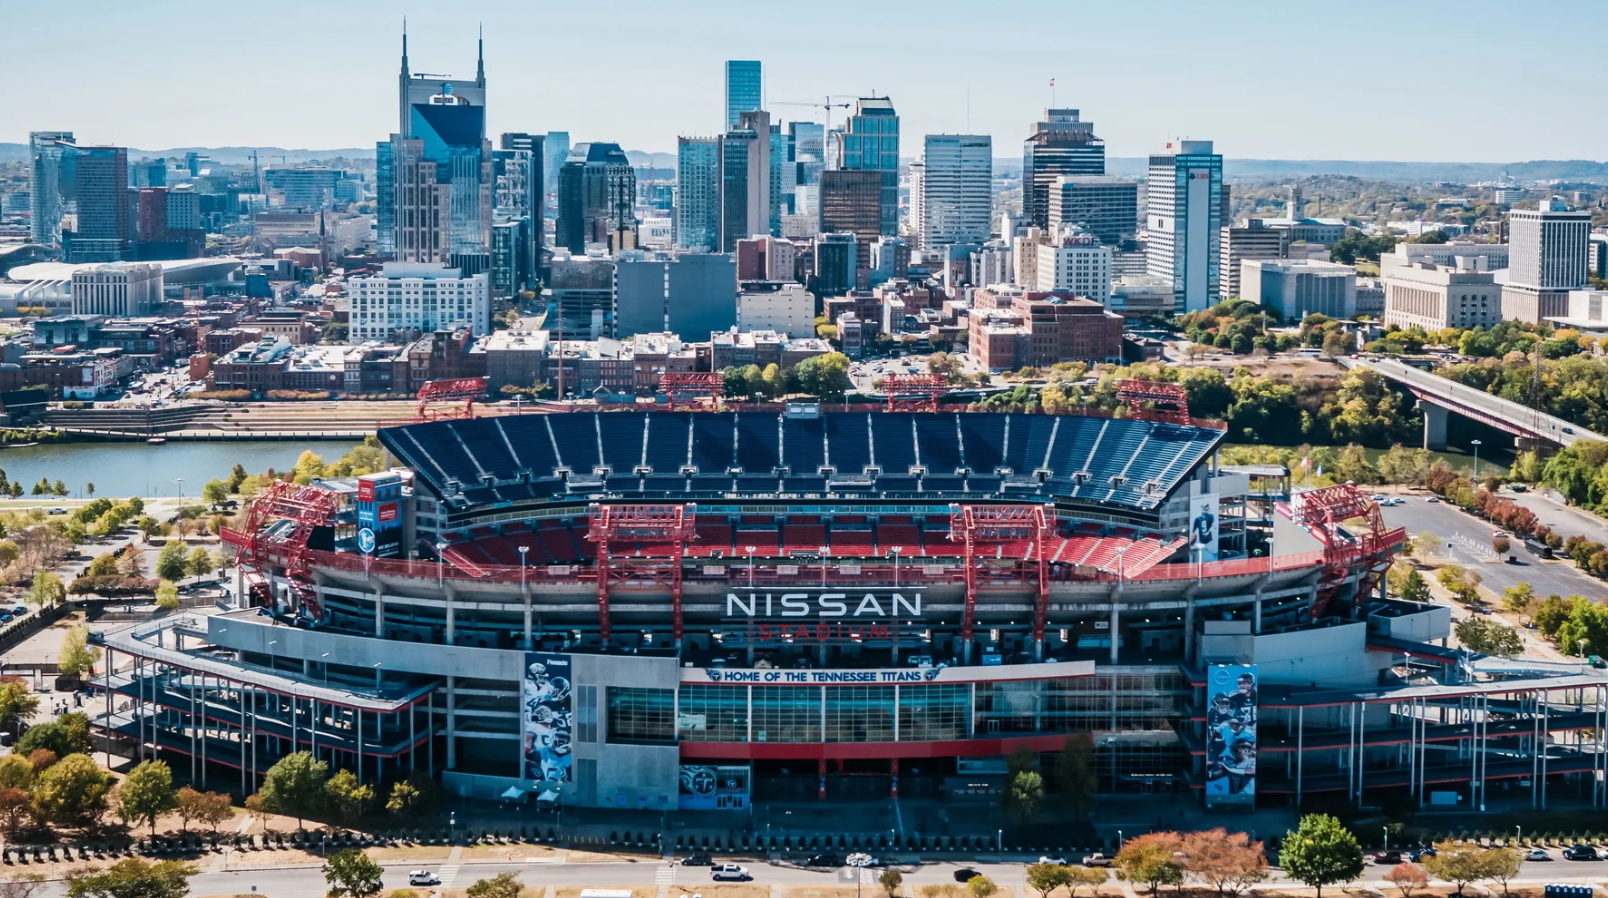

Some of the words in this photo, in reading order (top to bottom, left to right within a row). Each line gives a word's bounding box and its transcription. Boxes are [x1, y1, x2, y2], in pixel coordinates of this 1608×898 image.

[726, 593, 921, 617] NISSAN
[758, 624, 890, 640] STADIUM
[724, 671, 760, 682] HOME
[764, 672, 781, 682] OF
[784, 672, 807, 682] THE
[811, 672, 877, 682] TENNESSEE
[880, 671, 921, 682] TITANS
